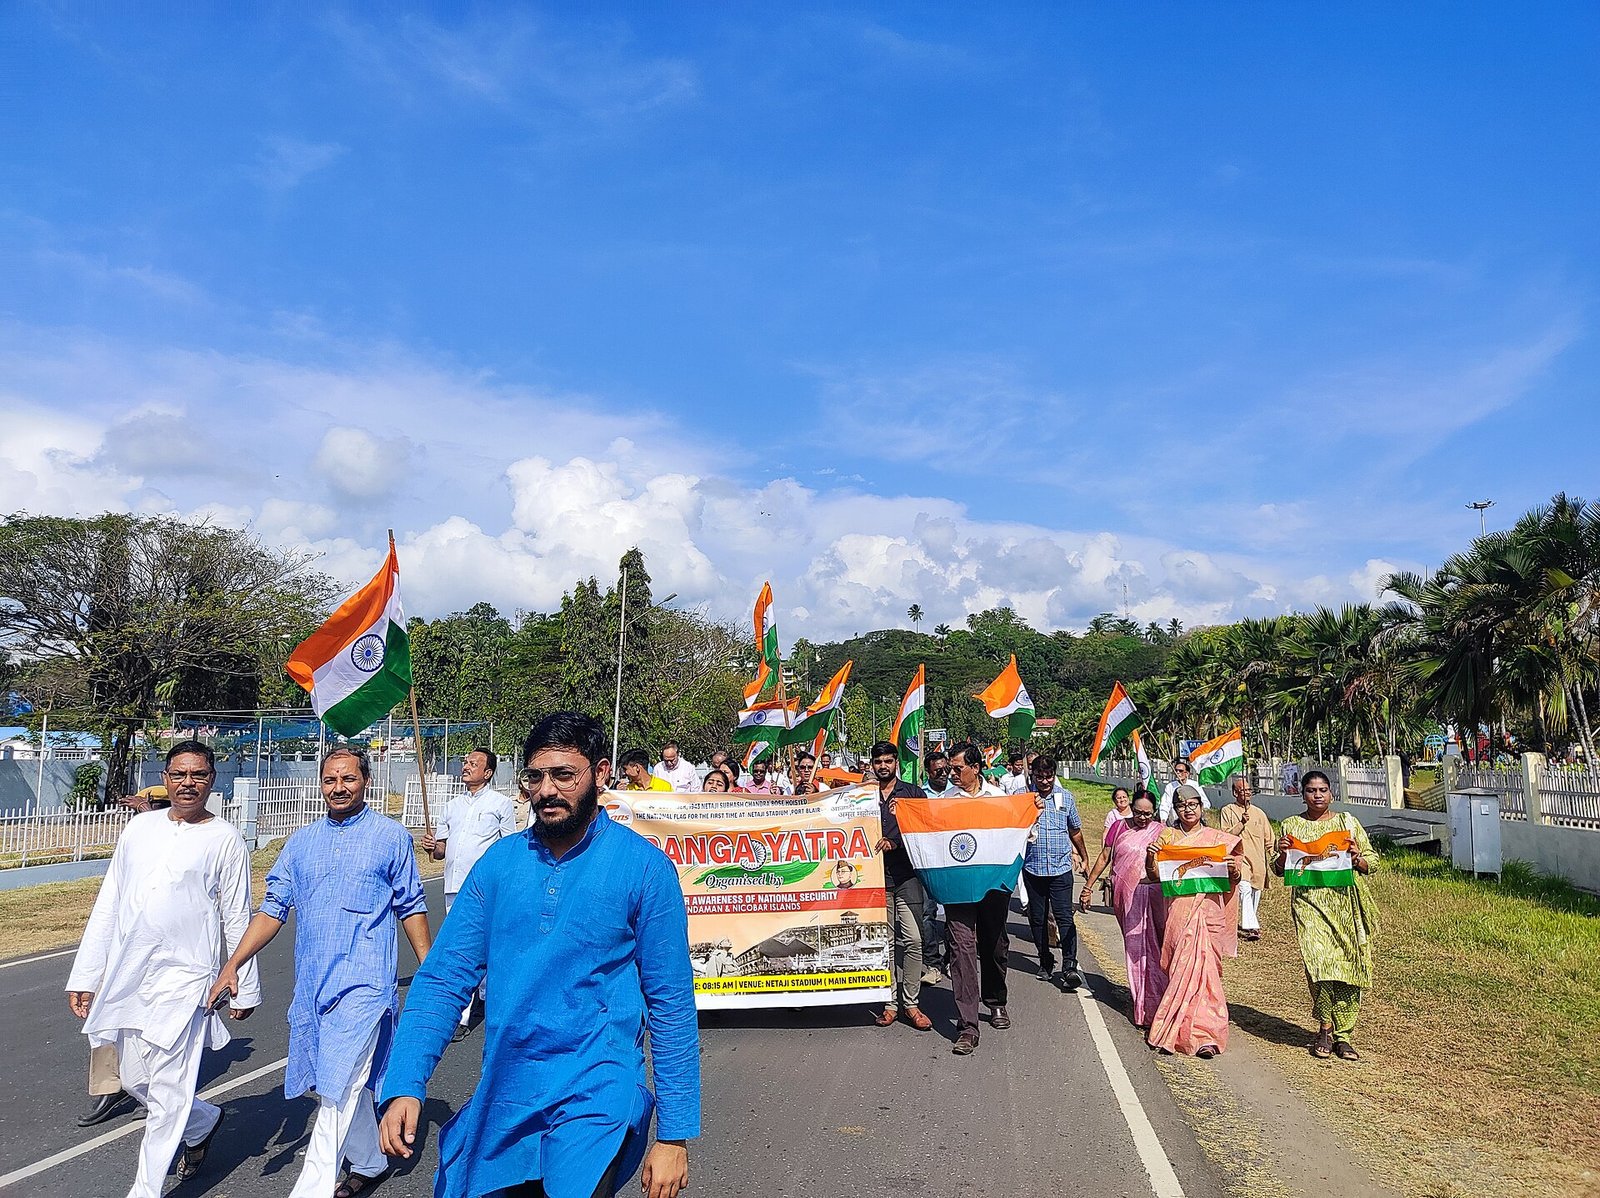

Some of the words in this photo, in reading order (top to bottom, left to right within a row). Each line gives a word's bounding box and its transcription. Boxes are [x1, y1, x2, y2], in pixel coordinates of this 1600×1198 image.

[701, 802, 719, 810] NETAJI
[720, 801, 744, 809] SUBHASH
[745, 800, 770, 808] CHANDRA
[764, 829, 871, 862] YATRA
[705, 873, 767, 890] Organised
[768, 873, 784, 888] by
[692, 895, 743, 905] AWARENESS
[745, 894, 756, 904] OF
[758, 893, 798, 903] NATIONAL
[800, 891, 838, 902] SECURITY
[687, 905, 723, 914] NDAMAN
[725, 904, 730, 912] &
[732, 903, 767, 912] NICOBAR
[769, 902, 801, 911] ISLANDS
[702, 982, 720, 990] 08:15
[722, 981, 733, 989] AM
[738, 980, 764, 988] VENUE:
[765, 979, 789, 987] NETAJI
[791, 978, 822, 987] STADIUM
[828, 976, 845, 985] MAIN
[848, 974, 887, 984] ENTRANCE)
